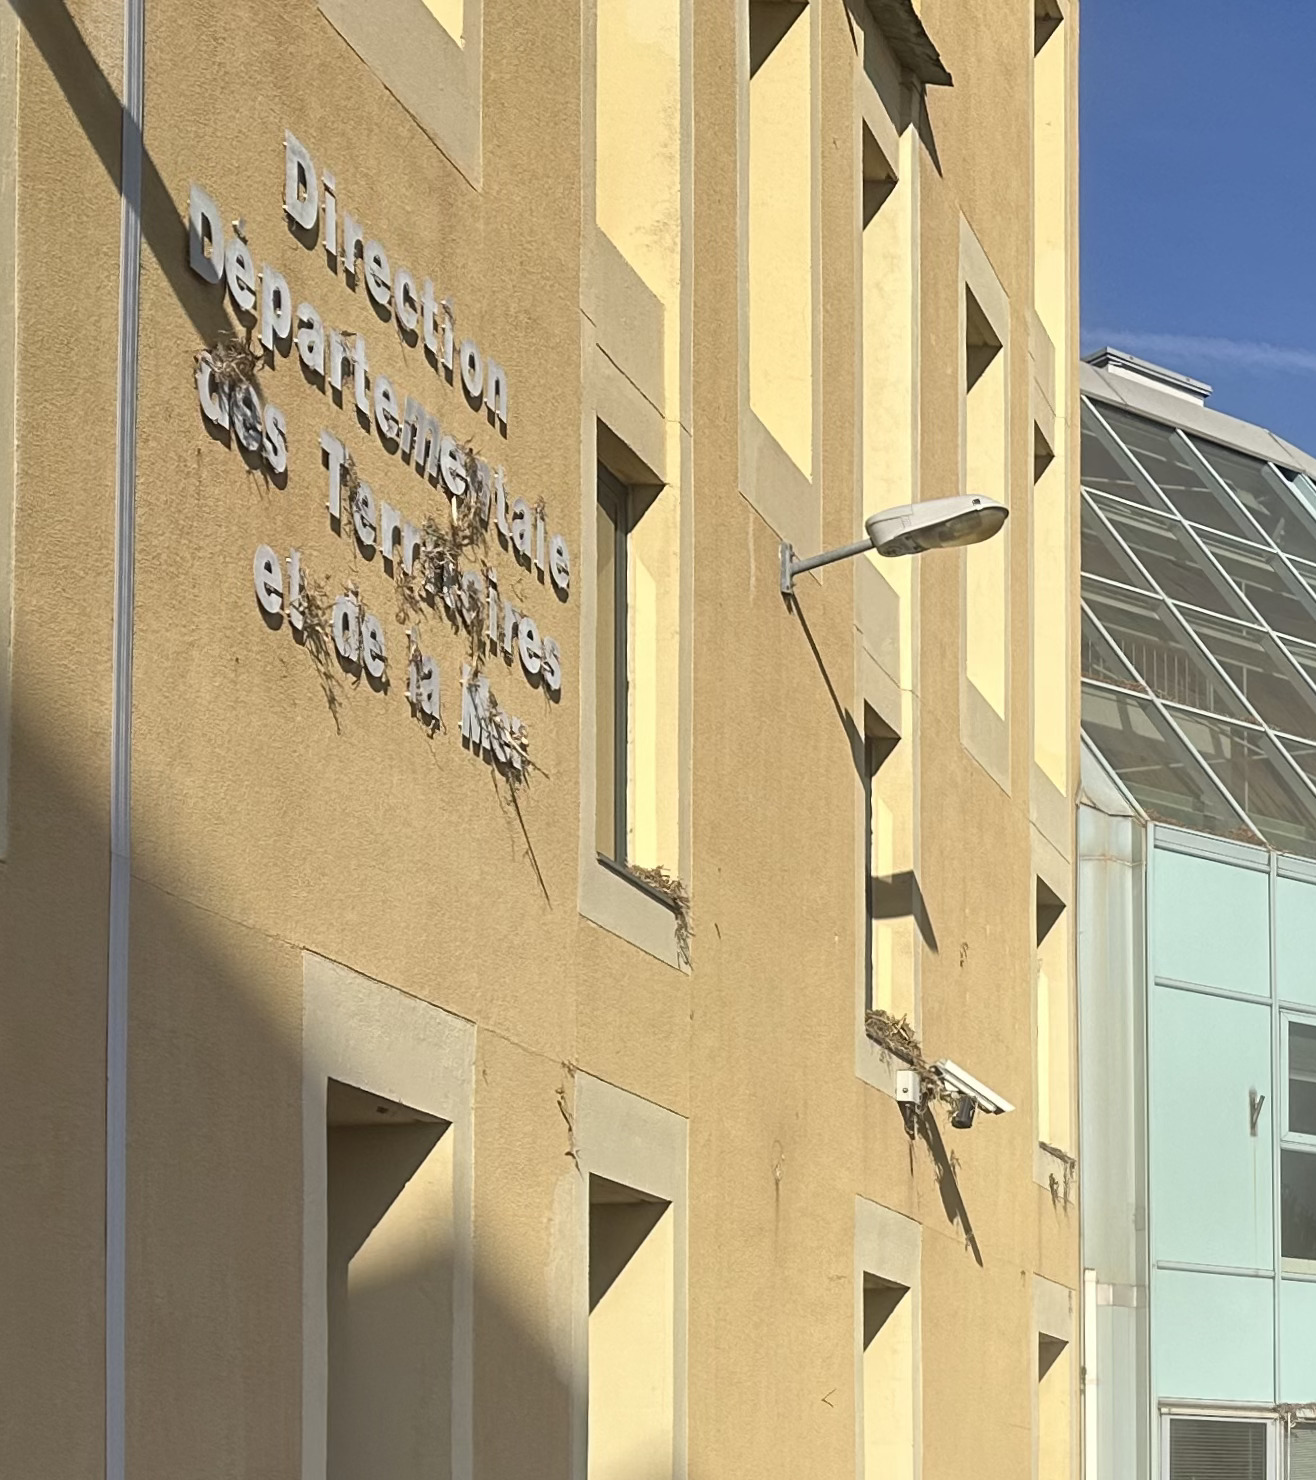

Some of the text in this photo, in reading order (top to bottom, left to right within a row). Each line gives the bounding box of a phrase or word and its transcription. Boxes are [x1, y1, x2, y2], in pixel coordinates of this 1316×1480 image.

[284, 128, 508, 426] Direction
[197, 350, 562, 691] des Terroires
[254, 544, 305, 631] et
[331, 582, 386, 678] de
[409, 626, 441, 721] la
